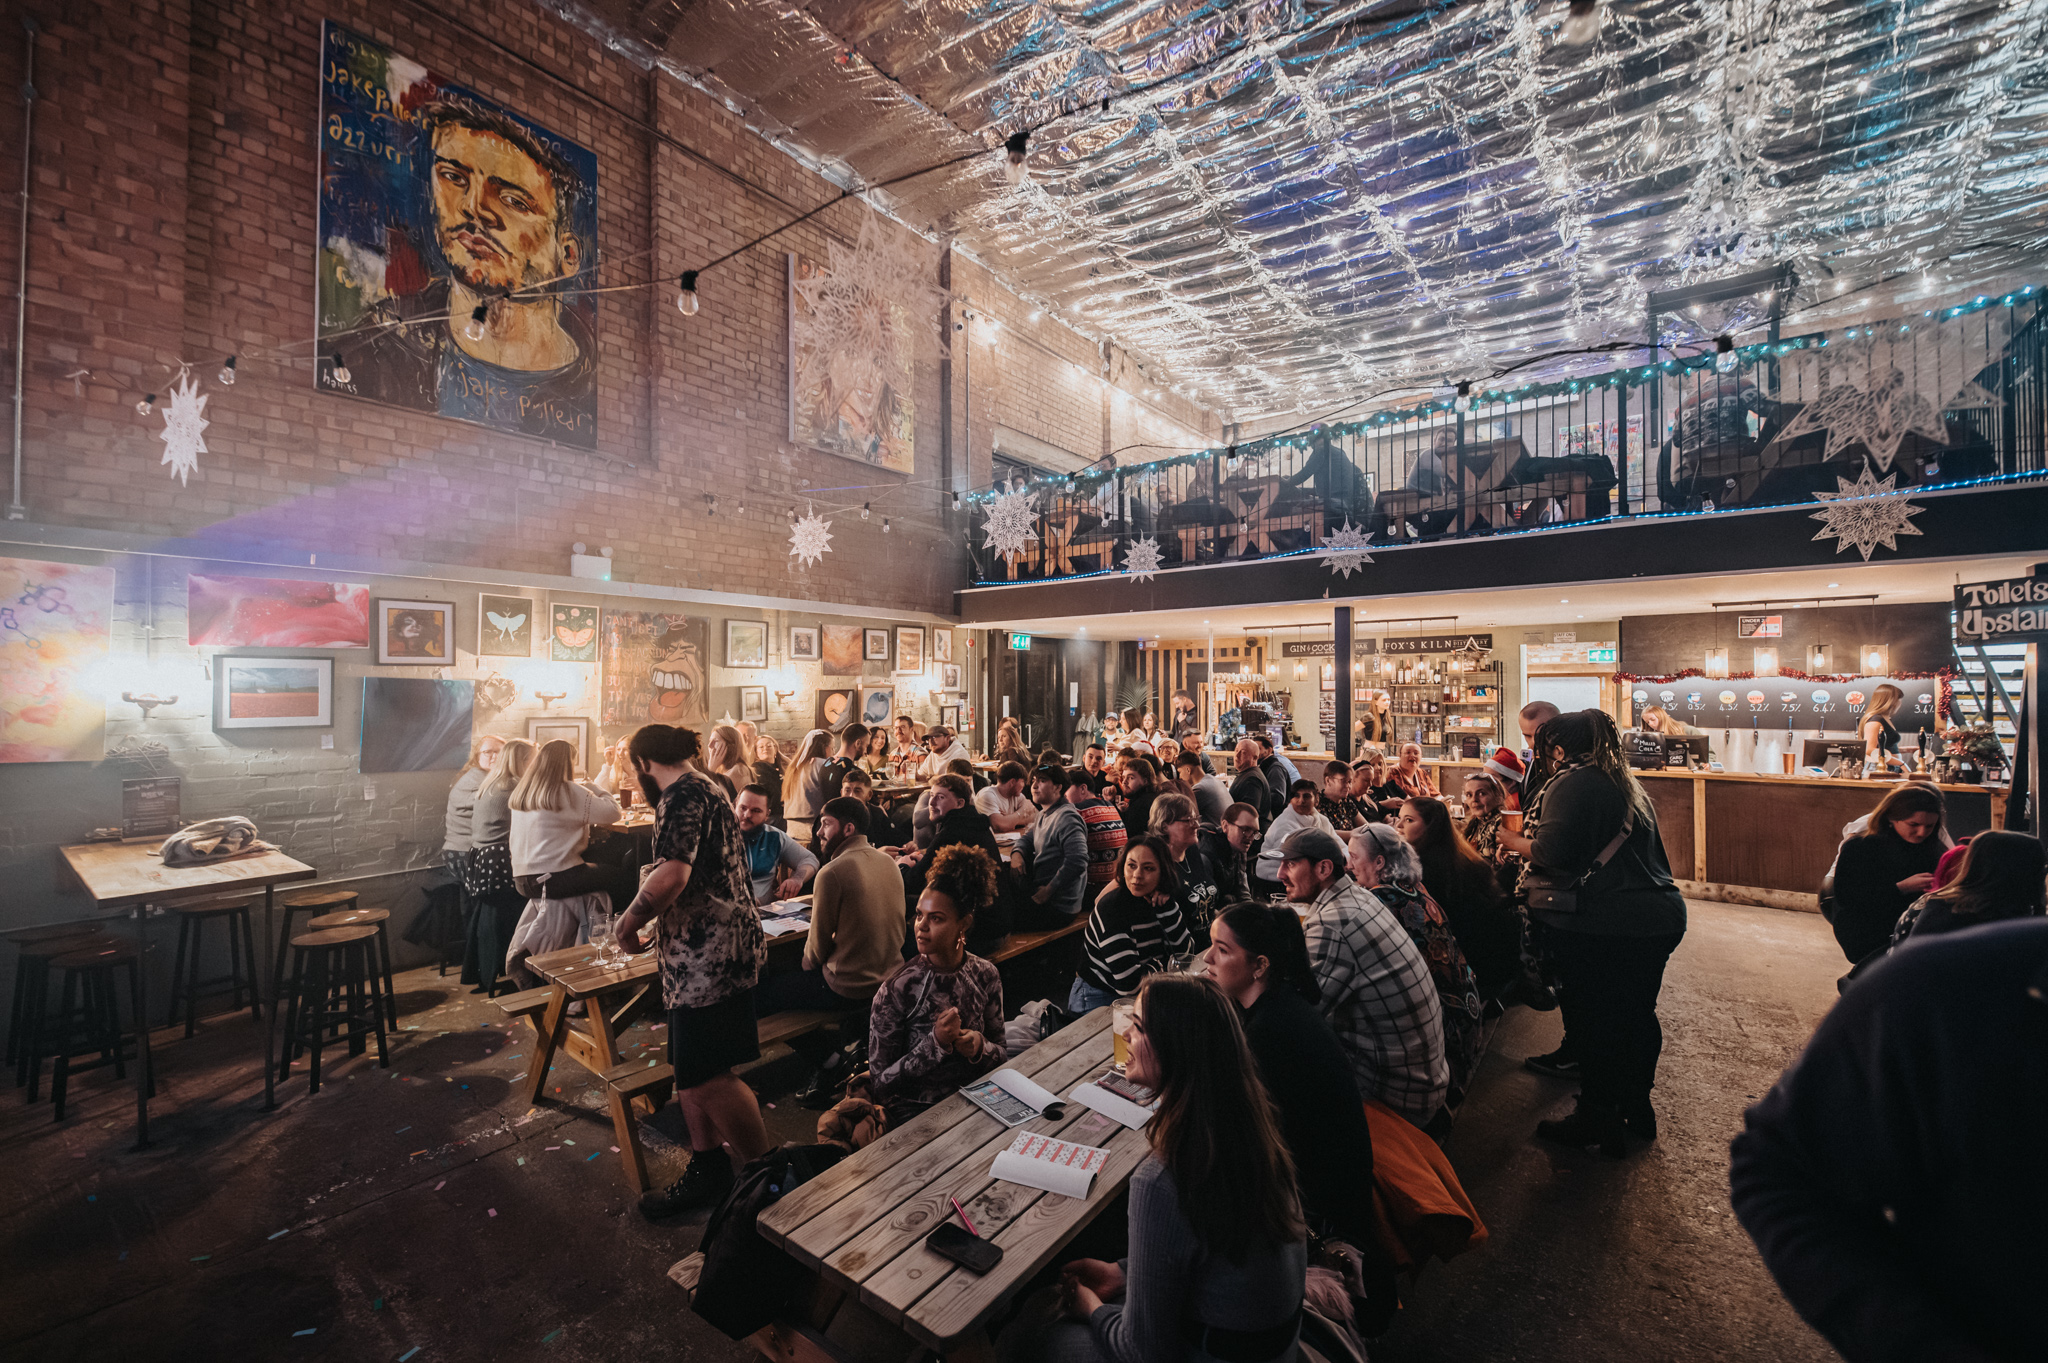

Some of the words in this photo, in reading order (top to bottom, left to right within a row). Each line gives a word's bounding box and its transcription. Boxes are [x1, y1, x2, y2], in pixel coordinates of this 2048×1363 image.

[1962, 579, 2048, 607] Toilets
[1290, 645, 1306, 653] GIN
[1420, 640, 1452, 649] KILN
